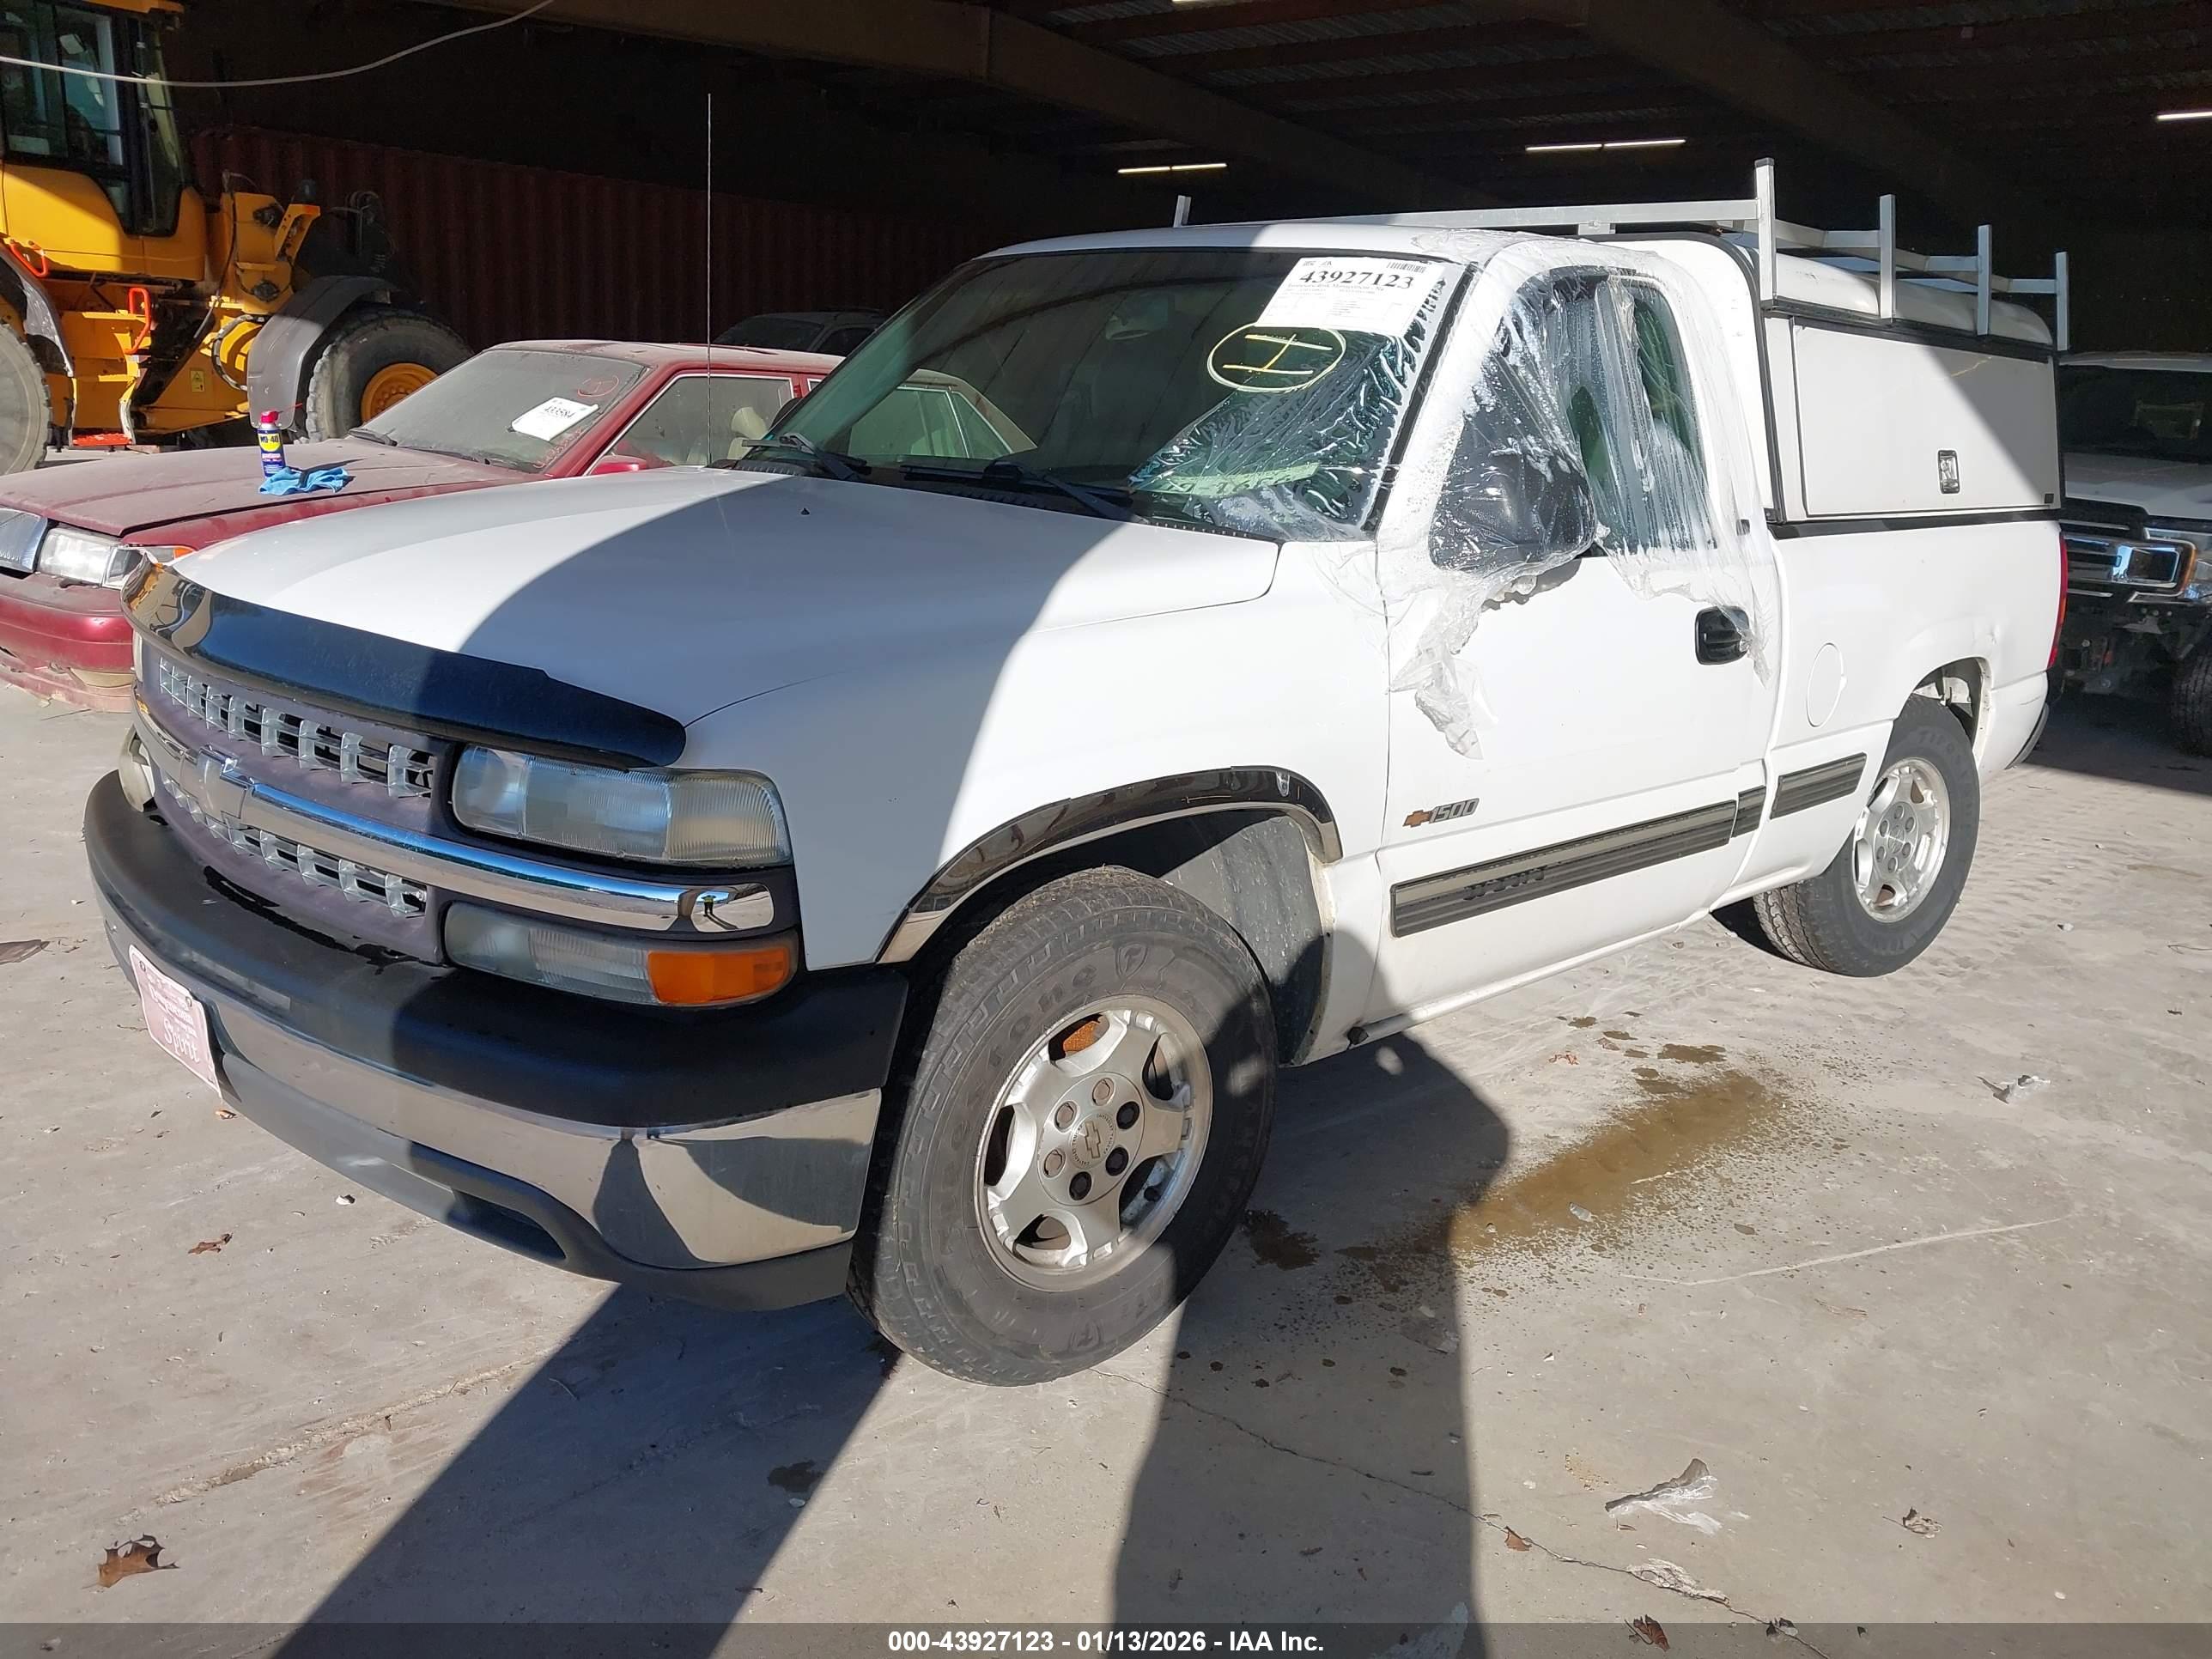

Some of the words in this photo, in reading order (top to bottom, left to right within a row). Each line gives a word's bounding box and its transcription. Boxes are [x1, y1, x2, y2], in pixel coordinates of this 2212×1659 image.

[1300, 270, 1414, 289] 43927123
[260, 435, 279, 444] WD-40
[1429, 798, 1480, 823] 1500
